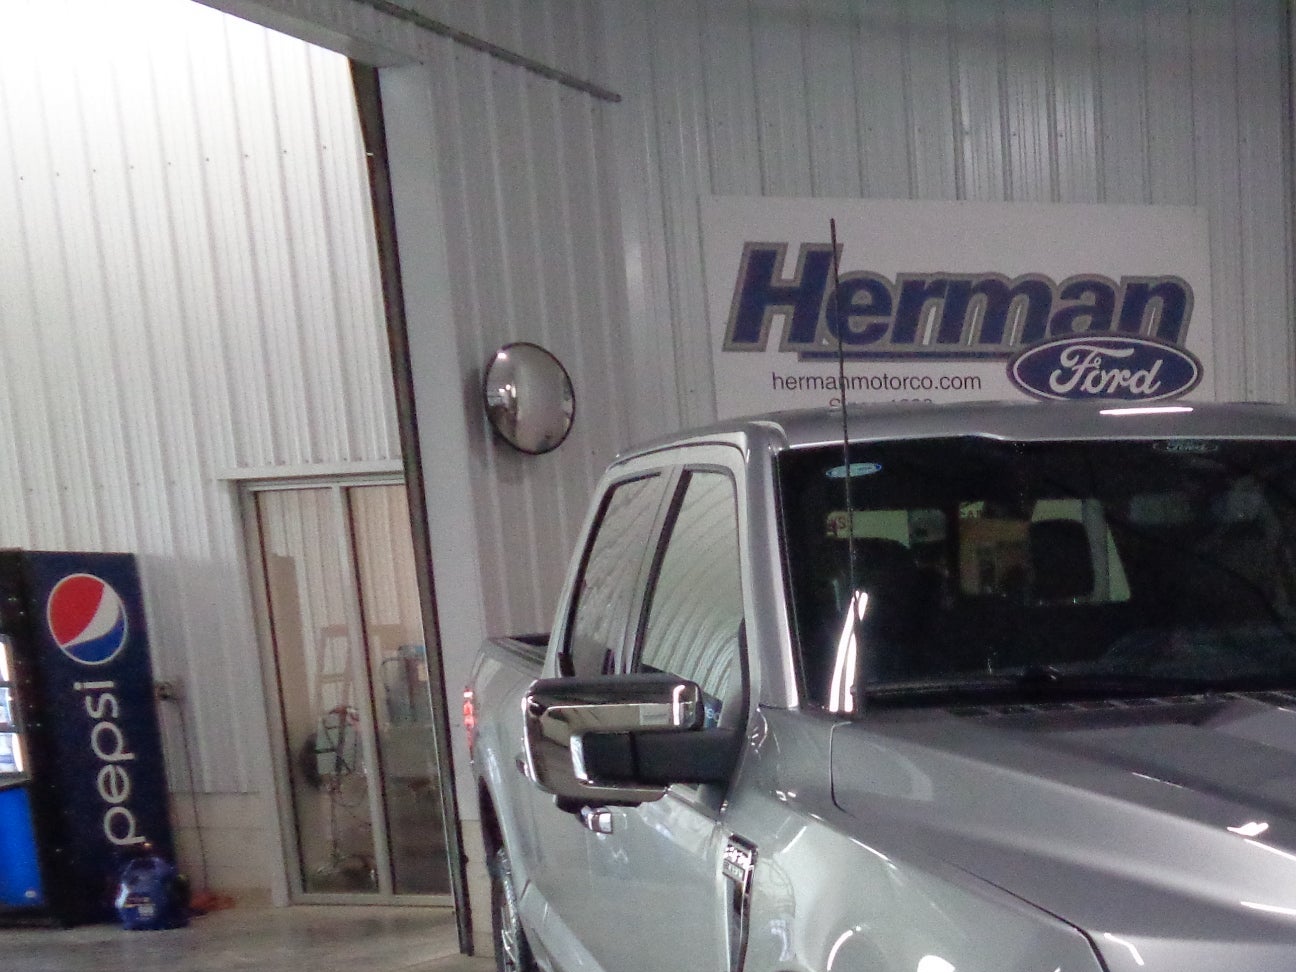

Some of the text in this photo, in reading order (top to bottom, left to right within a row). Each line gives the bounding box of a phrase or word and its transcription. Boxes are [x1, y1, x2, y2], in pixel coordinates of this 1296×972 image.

[722, 241, 1195, 352] Herman
[771, 371, 982, 391] hermanmotorco.com
[1049, 340, 1164, 396] Ford
[73, 680, 147, 845] pepsi
